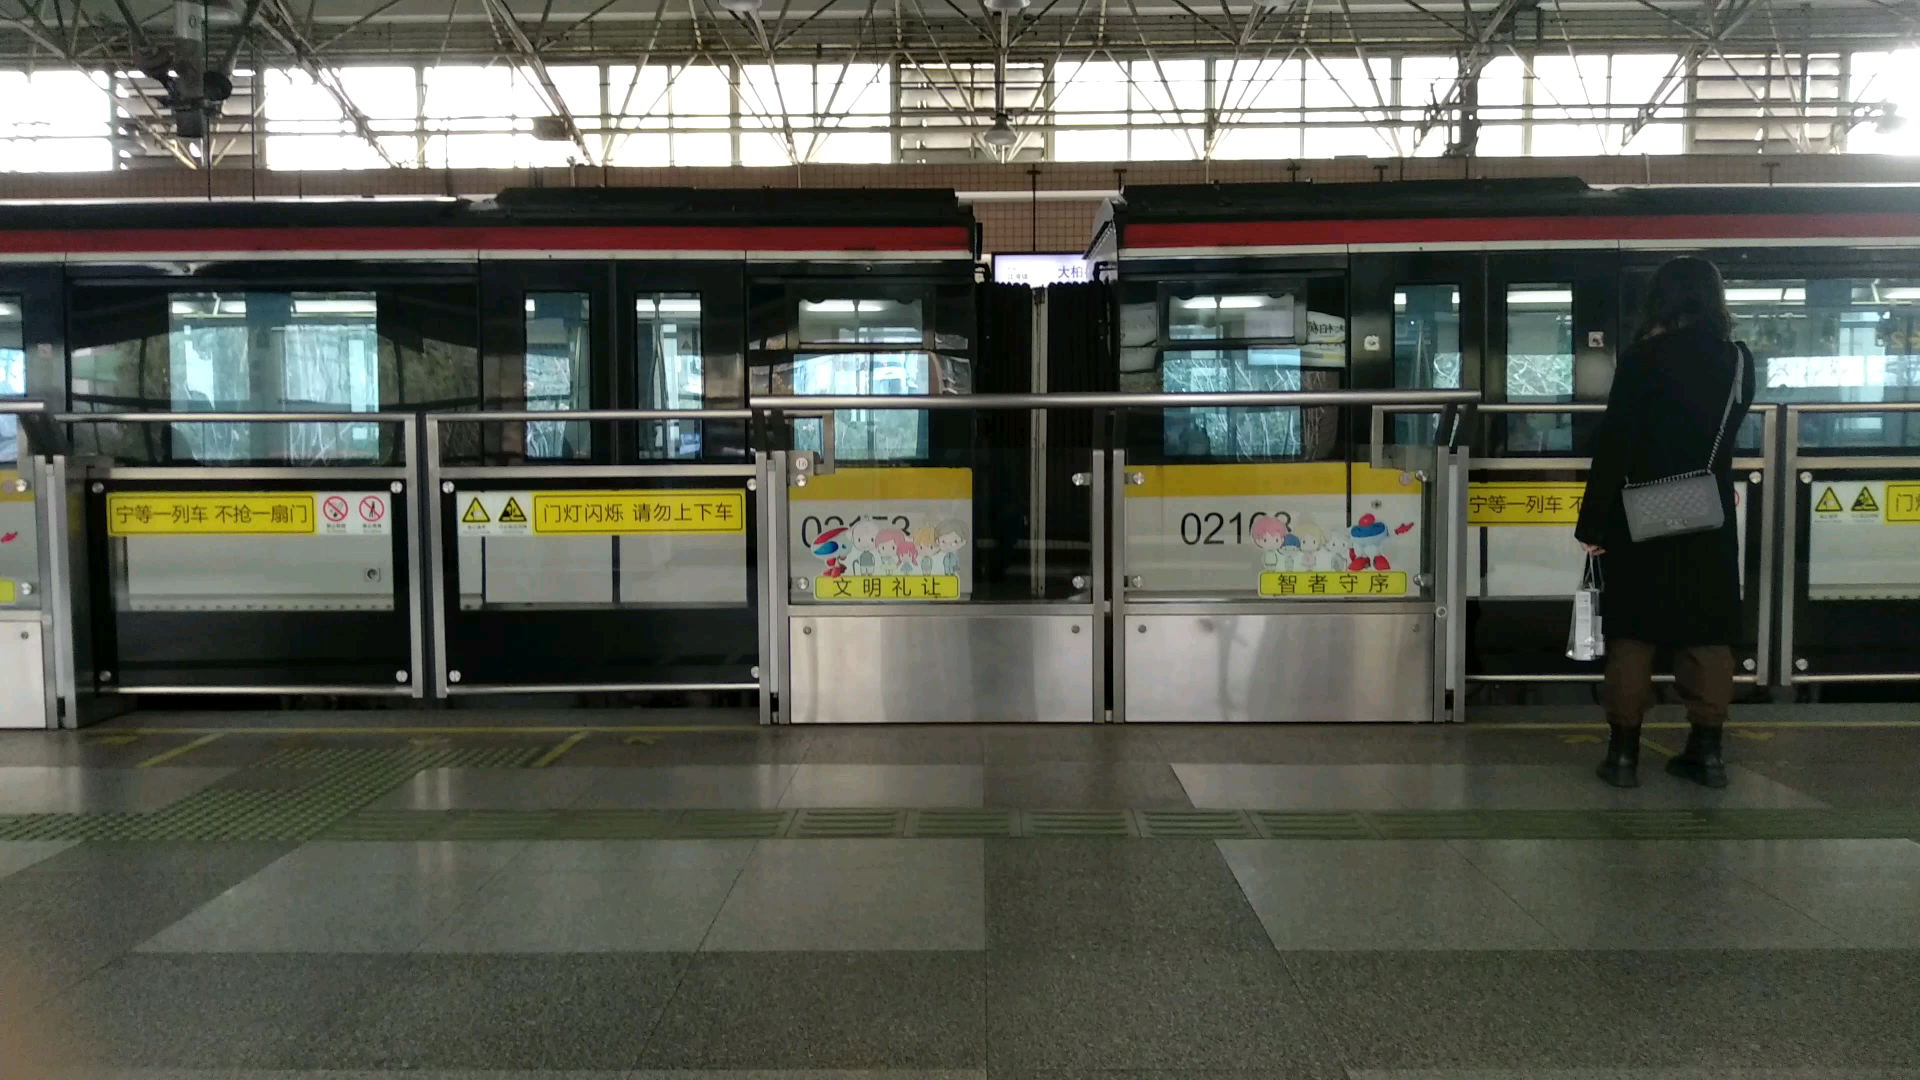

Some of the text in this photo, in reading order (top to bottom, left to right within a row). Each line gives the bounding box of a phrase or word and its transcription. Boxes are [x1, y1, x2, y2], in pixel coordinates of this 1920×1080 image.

[1058, 265, 1087, 279] 大柏
[115, 504, 307, 524] 宁等一列车 不抢一扇门
[543, 502, 734, 523] 门灯闪烁 请勿上下车
[1469, 495, 1563, 514] 宁等一列车
[833, 577, 941, 597] 文明礼让
[1277, 573, 1389, 594] 智者守序
